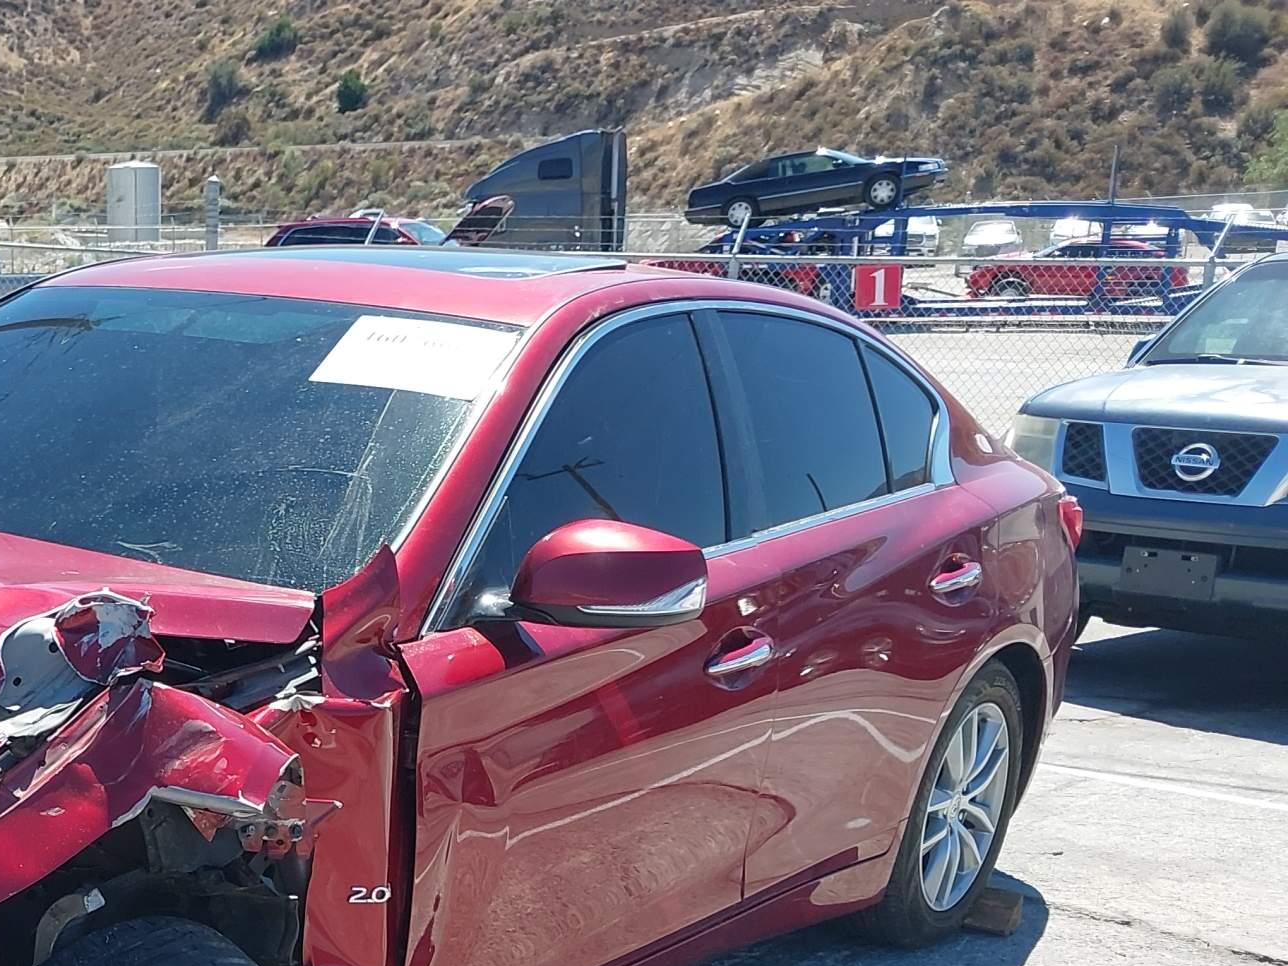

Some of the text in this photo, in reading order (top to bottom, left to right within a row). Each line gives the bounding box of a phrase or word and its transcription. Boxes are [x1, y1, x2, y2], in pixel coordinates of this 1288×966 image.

[869, 268, 889, 306] 1
[1174, 456, 1214, 466] NISSAN
[348, 886, 391, 903] 2.0
